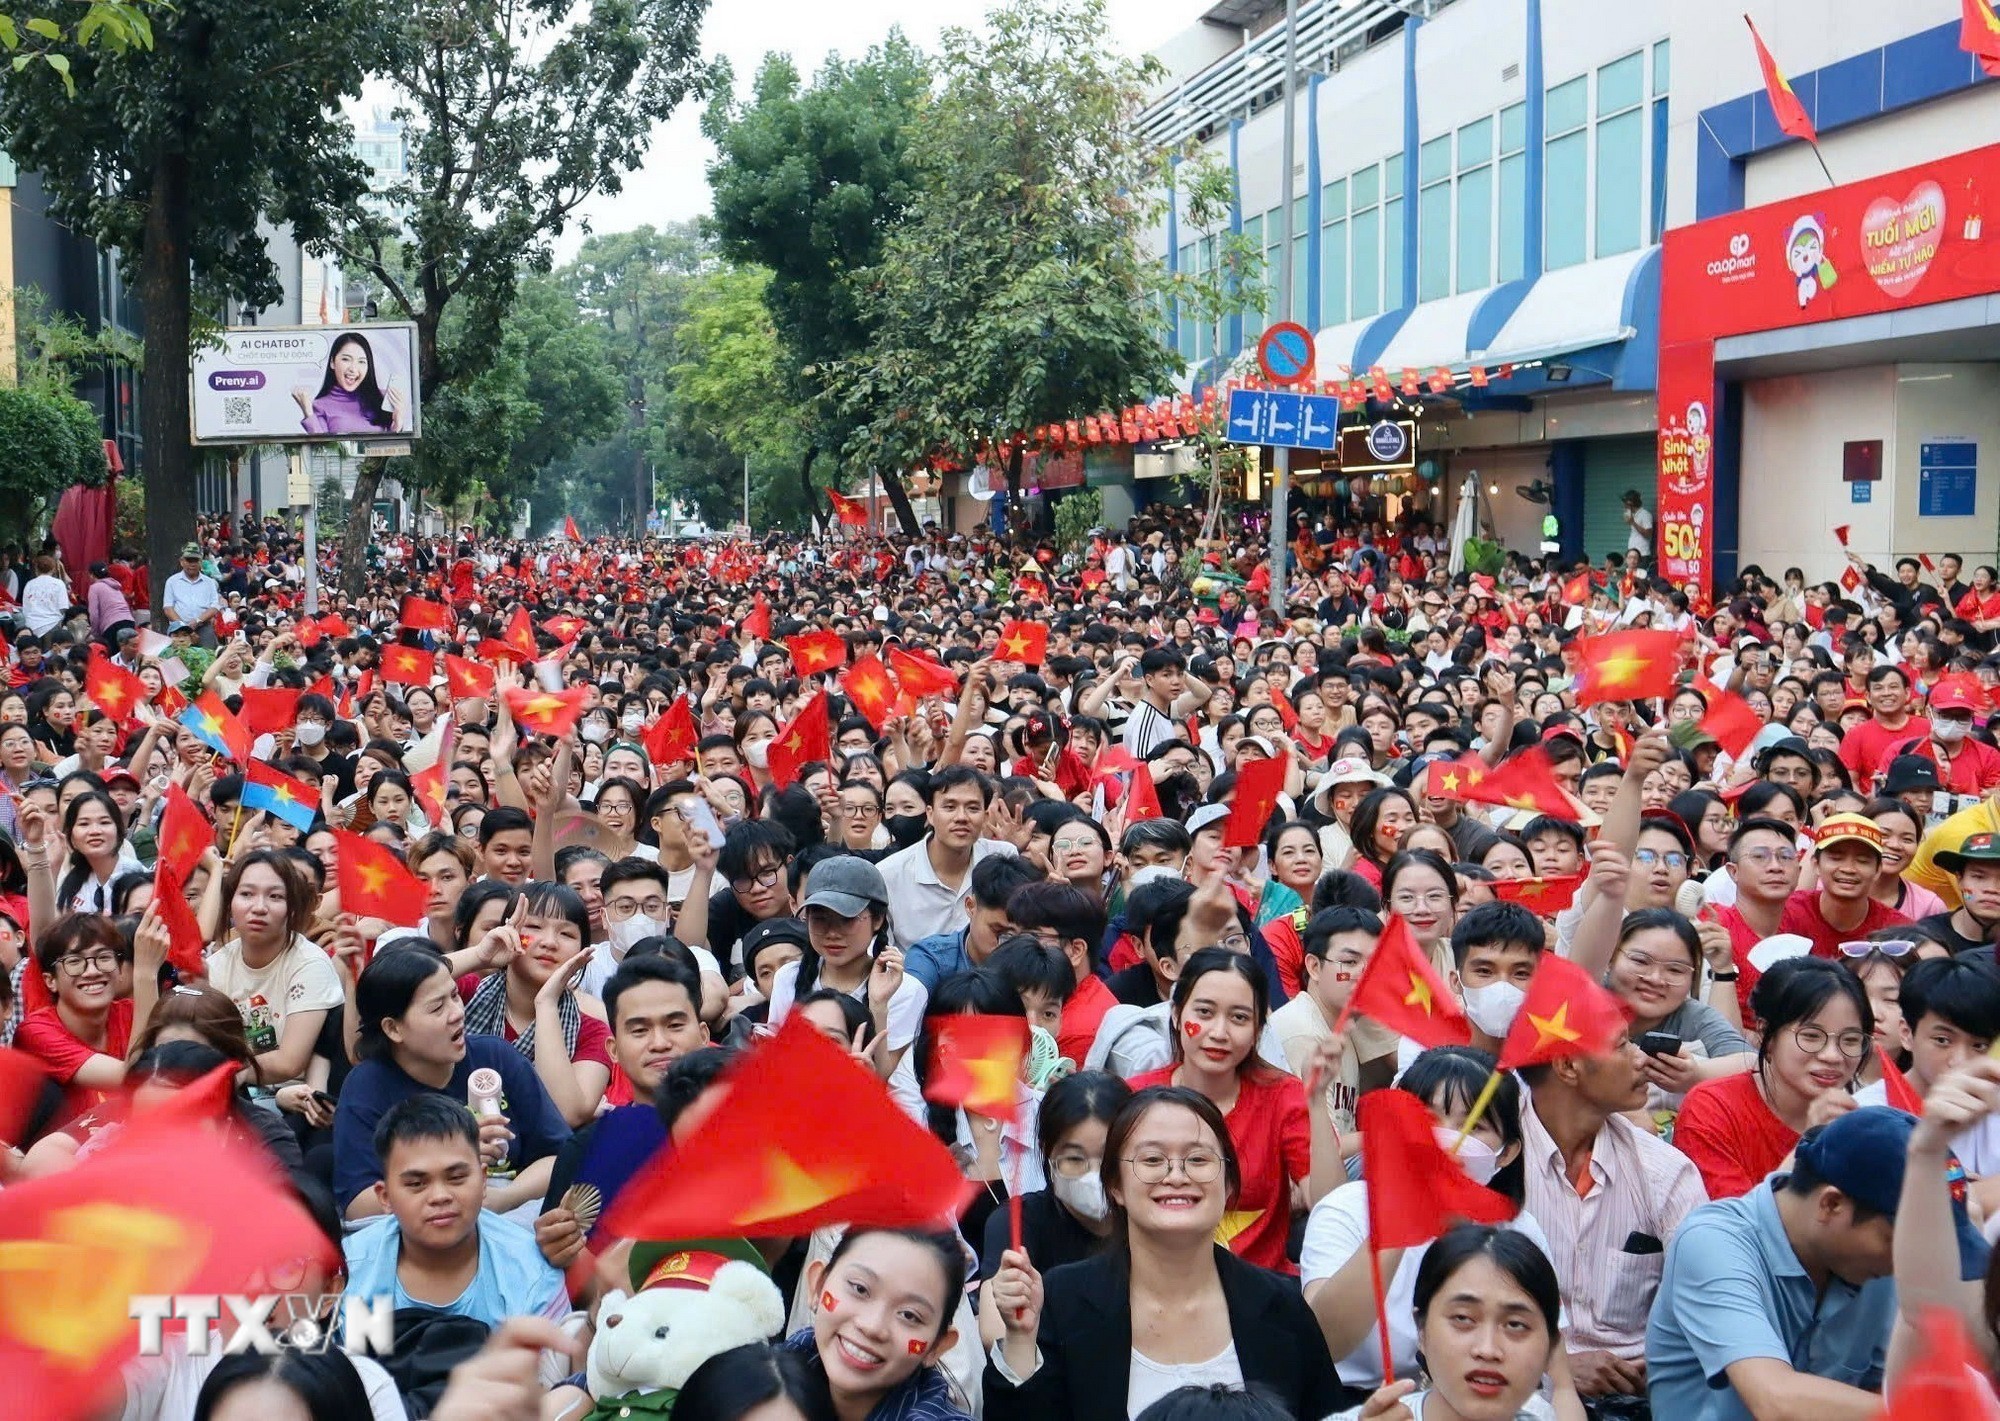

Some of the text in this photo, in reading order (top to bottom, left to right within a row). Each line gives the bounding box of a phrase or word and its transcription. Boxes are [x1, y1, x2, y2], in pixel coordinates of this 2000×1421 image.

[1866, 216, 1899, 247] TUỔI
[241, 340, 251, 349] AI
[254, 339, 306, 349] CHATBOT
[215, 375, 259, 387] Preny.ai
[1664, 436, 1687, 456] Sinh
[1662, 457, 1689, 475] Nhật
[1664, 522, 1703, 560] 50%
[1688, 560, 1700, 575] 50
